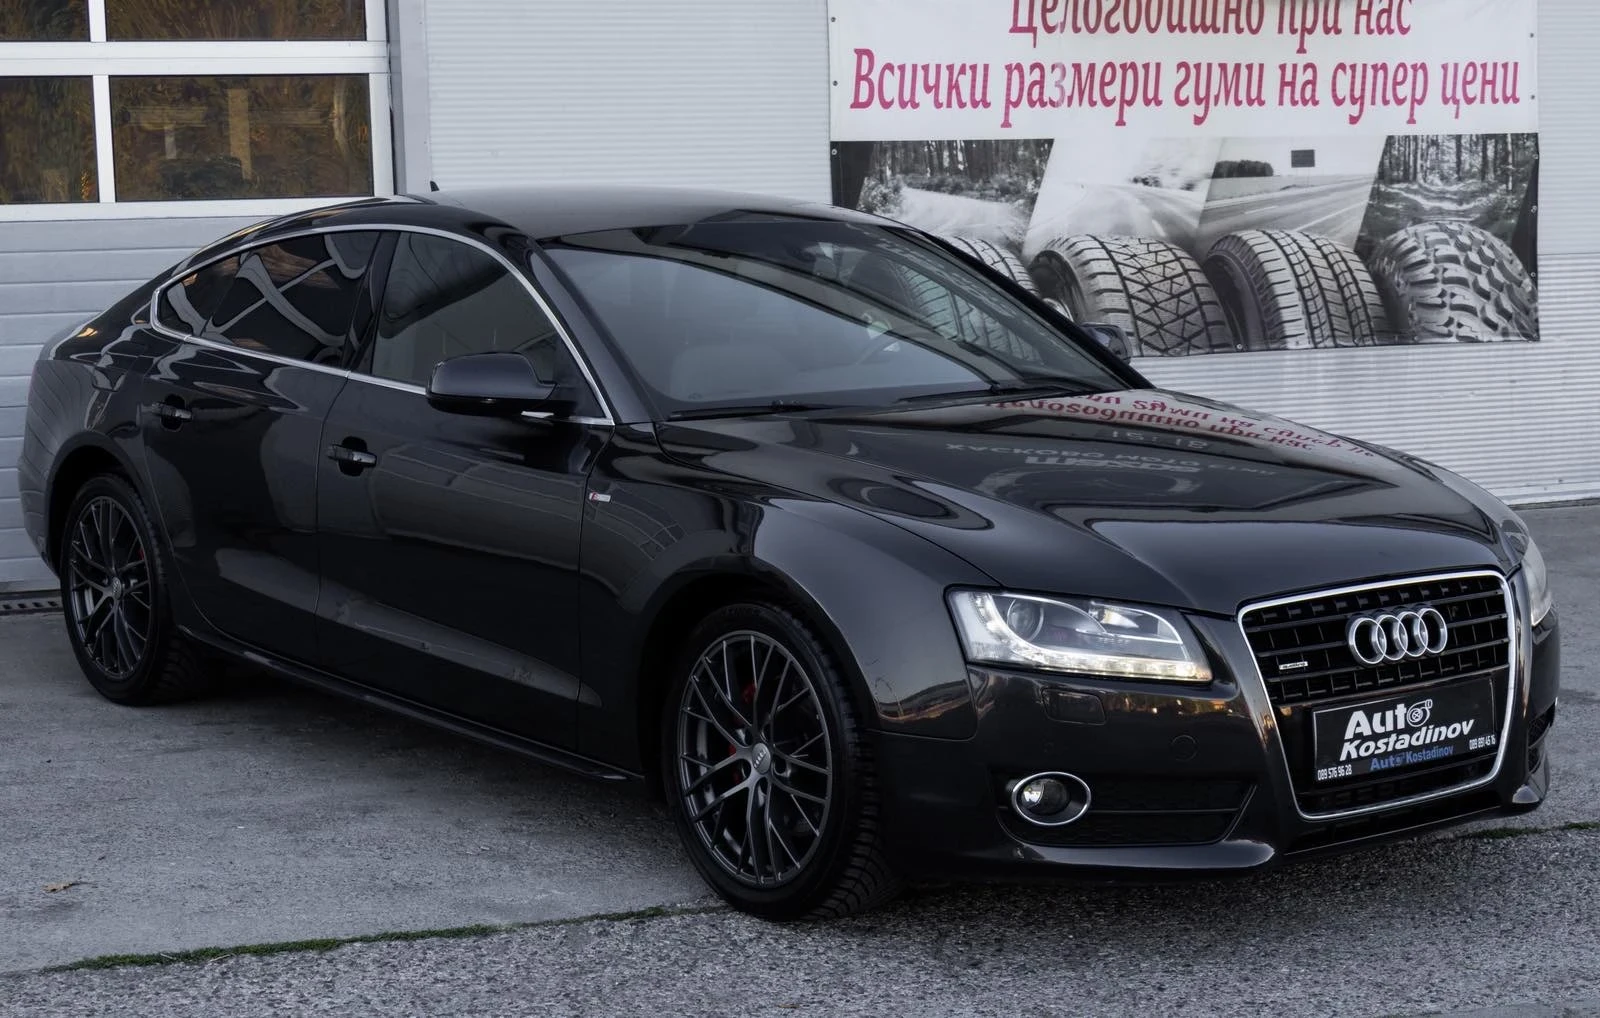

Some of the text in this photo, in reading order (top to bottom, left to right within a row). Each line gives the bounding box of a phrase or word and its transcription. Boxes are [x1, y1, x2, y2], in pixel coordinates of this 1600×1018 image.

[1276, 0, 1342, 54] при
[1353, 0, 1414, 36] нас
[849, 48, 1521, 128] Всички размери гуми на супер цени
[1339, 719, 1475, 762] Kostadinov
[1406, 745, 1454, 764] Kostadinov
